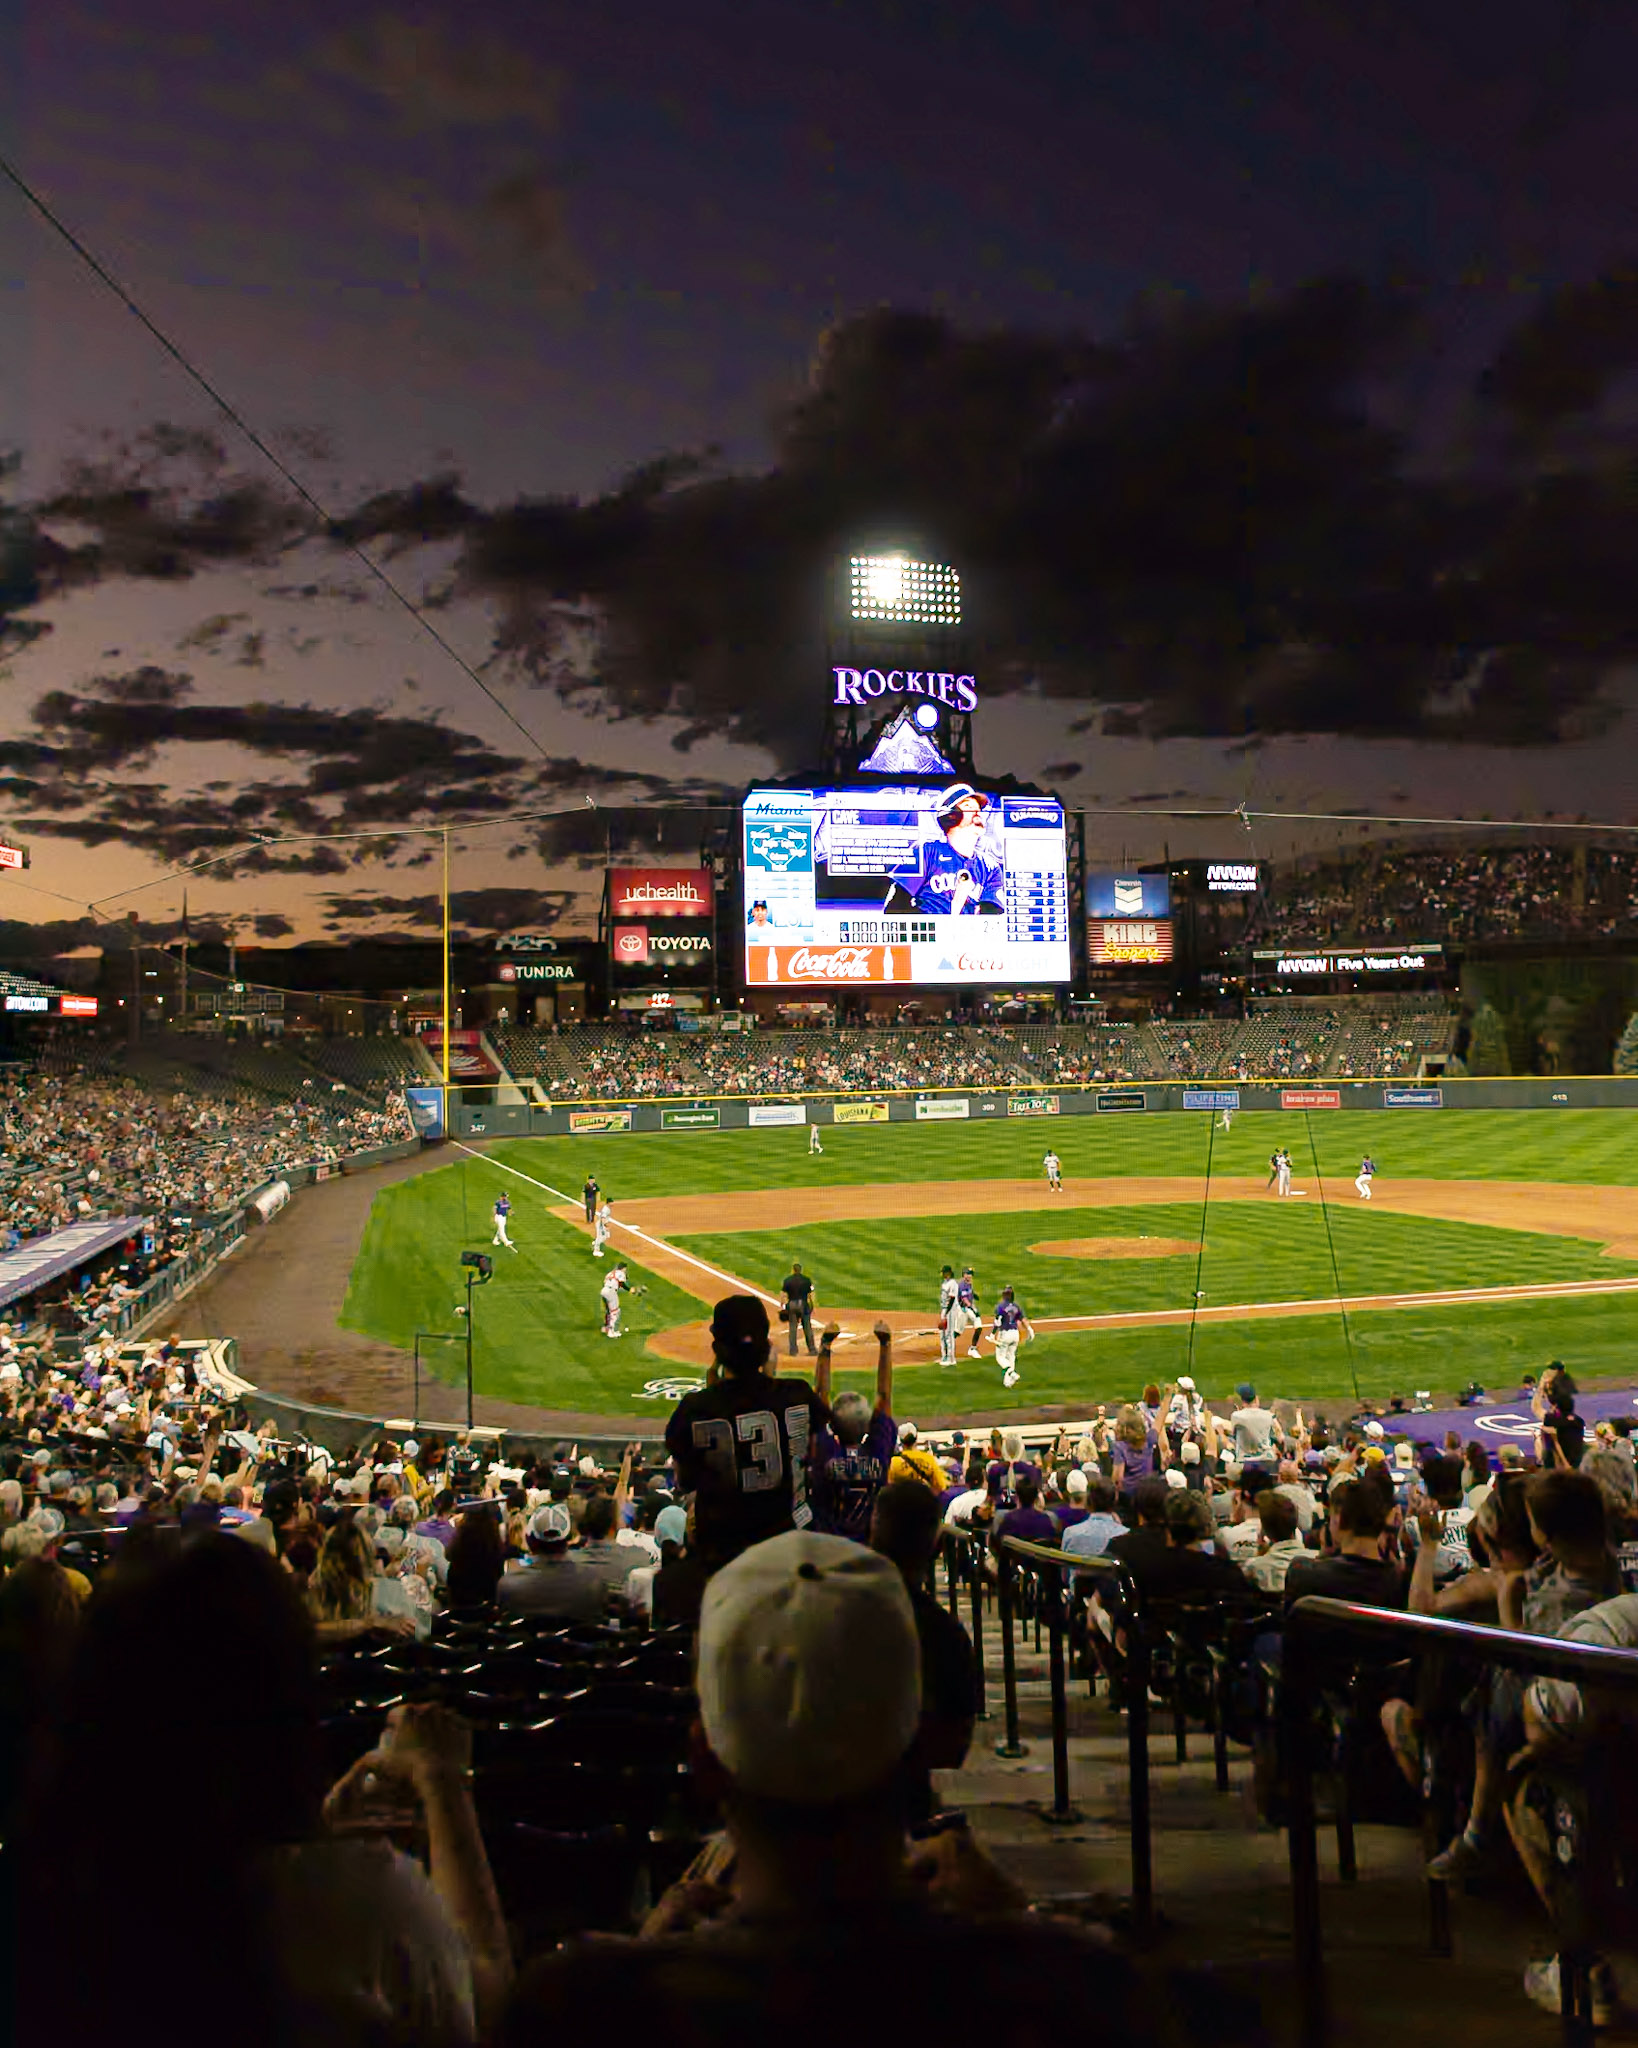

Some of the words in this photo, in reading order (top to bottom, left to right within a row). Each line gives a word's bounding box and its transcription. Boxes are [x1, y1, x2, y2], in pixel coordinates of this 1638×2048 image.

[832, 666, 978, 712] ROCKIES
[755, 802, 804, 816] Miami
[626, 882, 698, 901] uchealth
[1103, 924, 1158, 943] KING
[648, 936, 712, 951] TOYOTA
[1337, 958, 1364, 970] Five
[1364, 957, 1399, 969] Years
[1399, 956, 1425, 968] Out
[515, 965, 575, 979] TUNDRA
[837, 1108, 869, 1122] LOUISIANA
